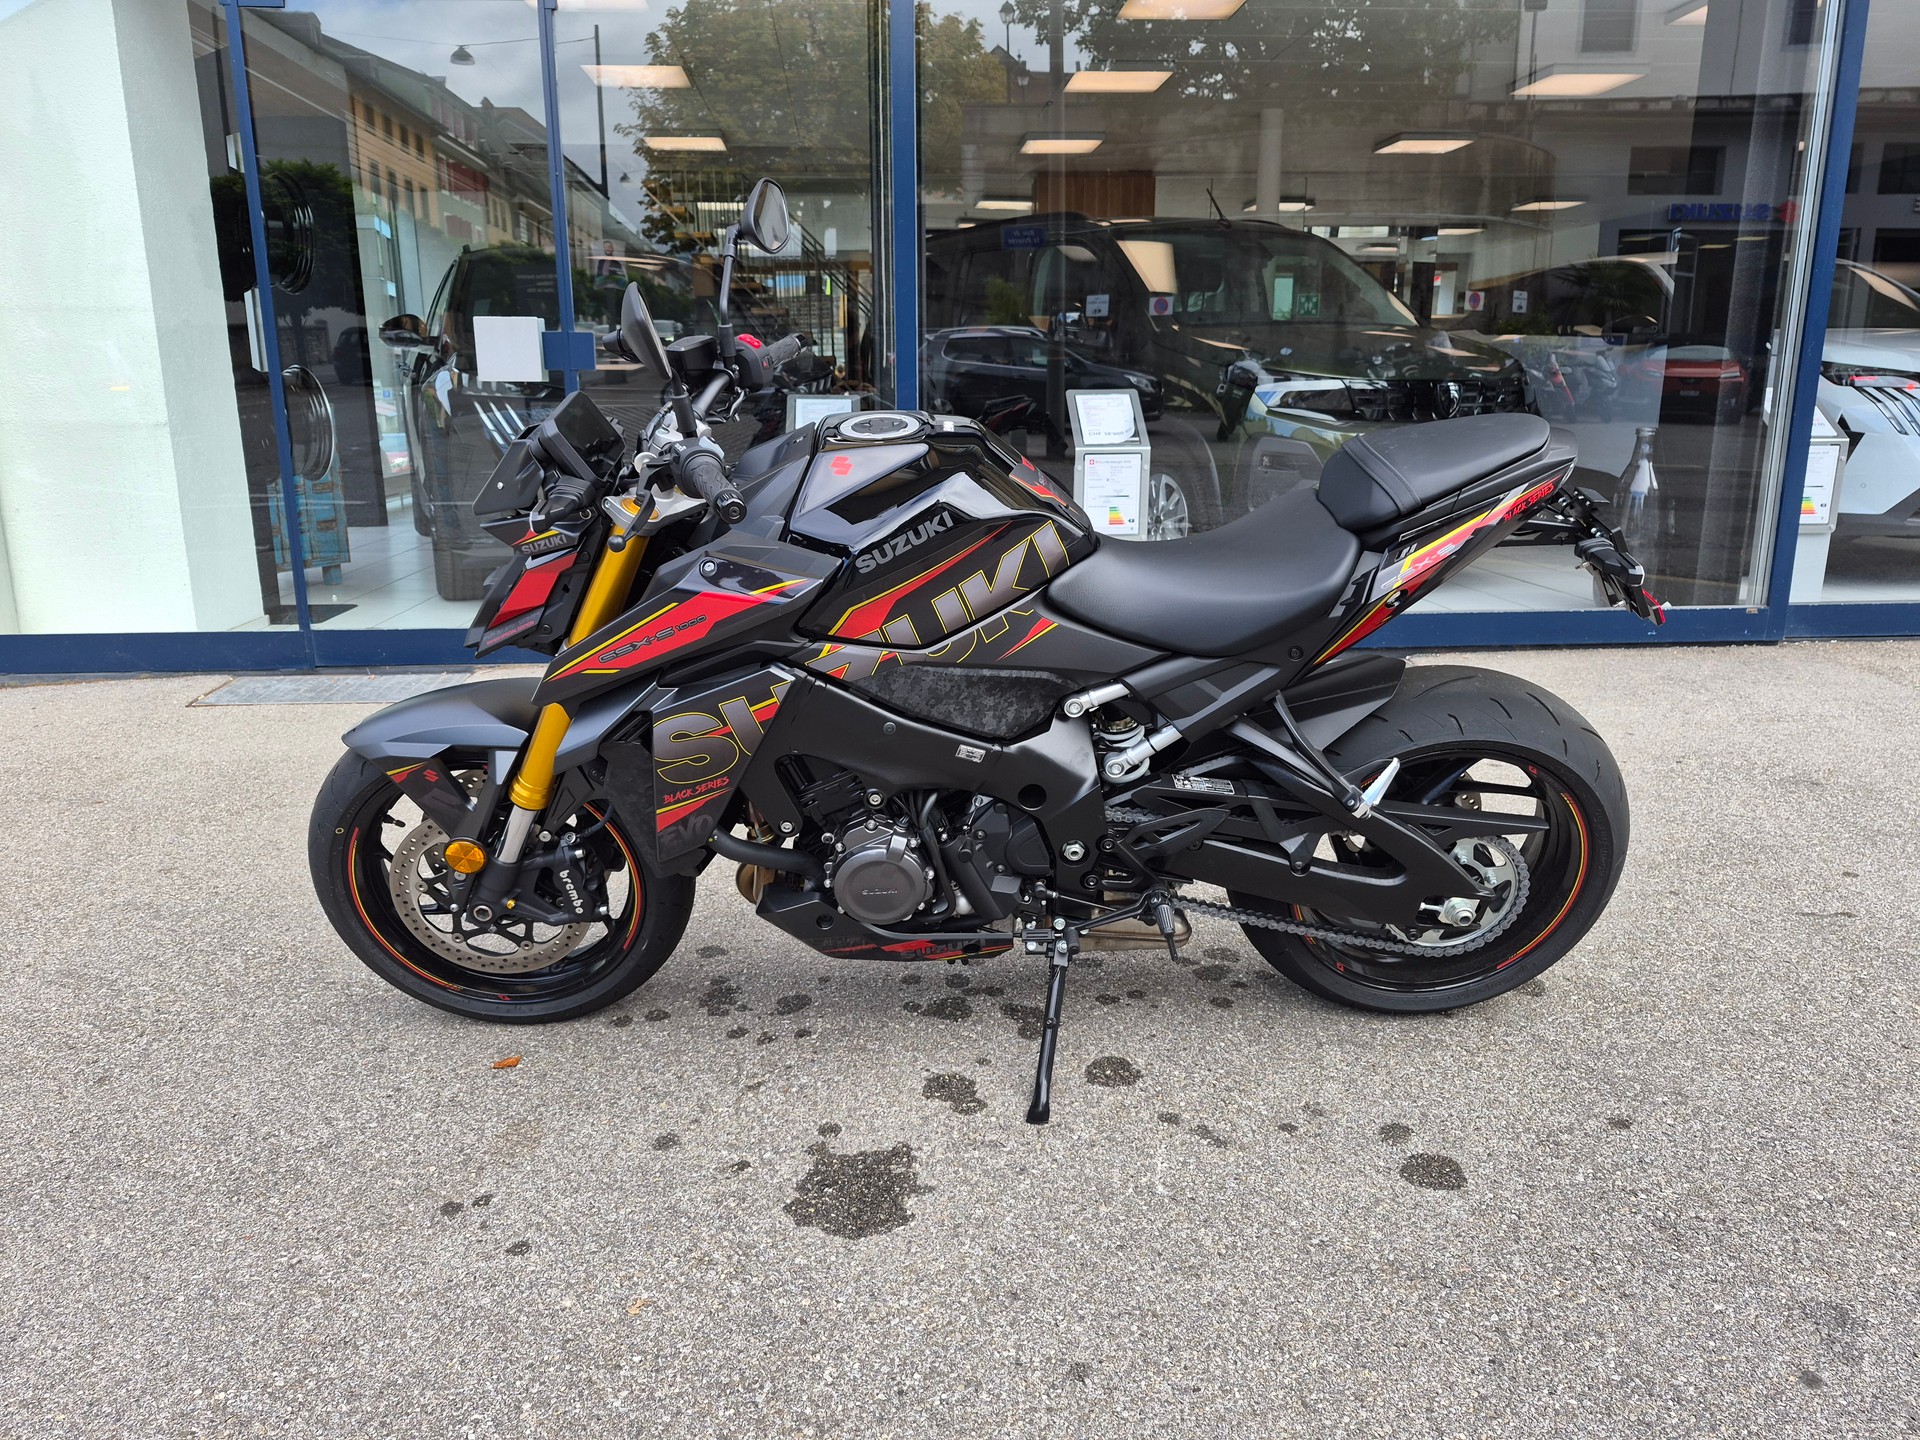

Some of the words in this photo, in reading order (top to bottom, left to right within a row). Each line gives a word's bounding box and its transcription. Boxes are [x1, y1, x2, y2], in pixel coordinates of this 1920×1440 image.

[1503, 500, 1528, 522] BLACK
[1527, 482, 1555, 508] SERIES
[521, 534, 568, 555] SUZUKI
[854, 510, 955, 574] SUZUKI
[598, 626, 675, 663] GSX-S
[675, 614, 707, 632] 1000
[663, 787, 693, 804] BLACK
[695, 776, 730, 794] SERIES
[657, 813, 714, 845] EVO
[559, 869, 584, 914] brembo
[900, 938, 986, 959] SUZUKI
